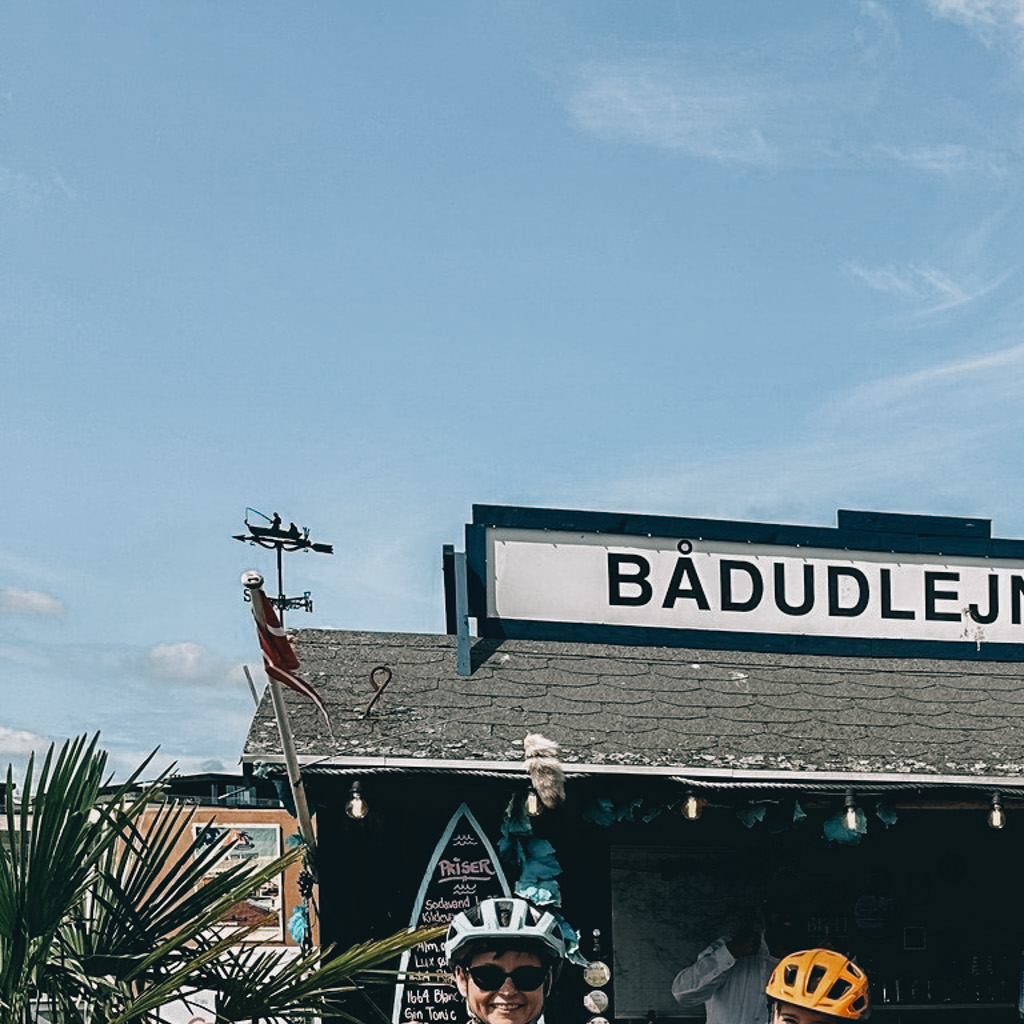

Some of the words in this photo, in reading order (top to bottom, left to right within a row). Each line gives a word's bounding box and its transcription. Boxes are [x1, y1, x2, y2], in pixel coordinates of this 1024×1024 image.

[438, 857, 496, 877] PRISER
[404, 1007, 424, 1021] Gin
[425, 1005, 458, 1021] Tonic
